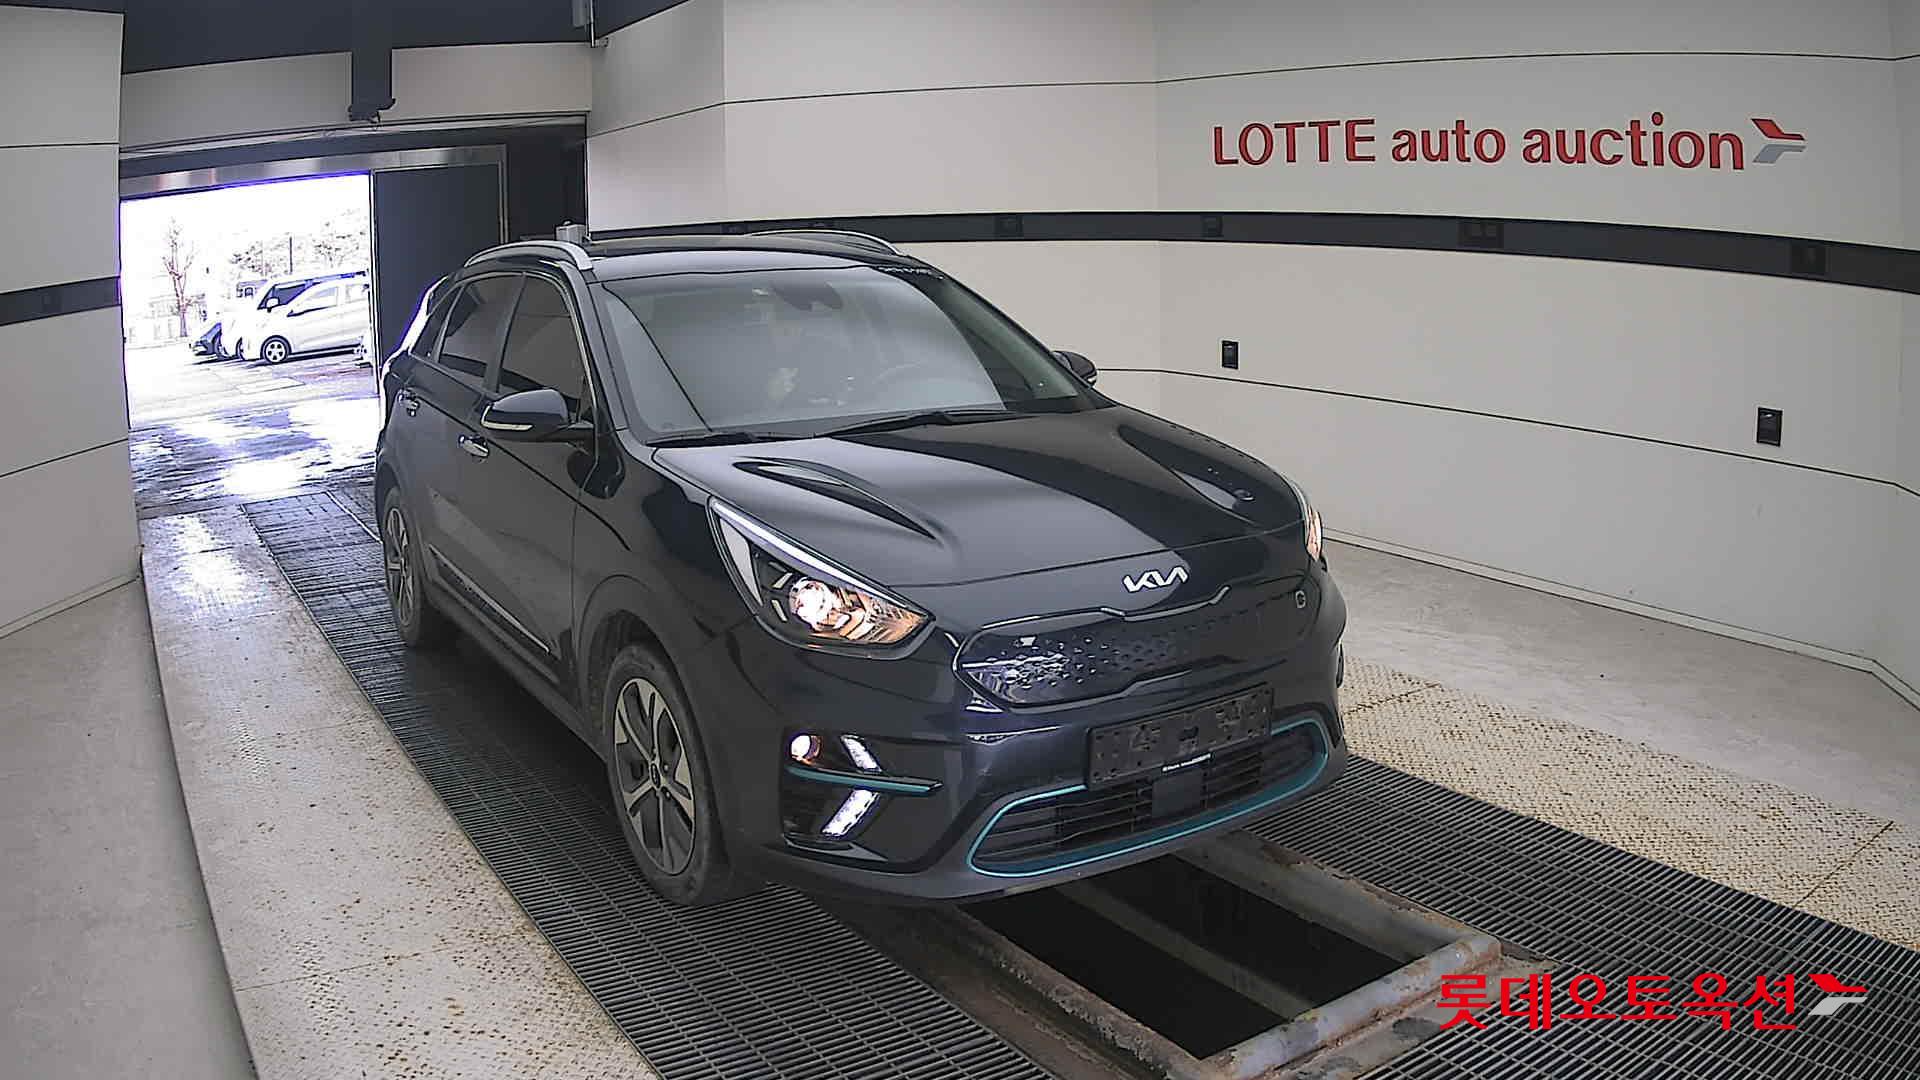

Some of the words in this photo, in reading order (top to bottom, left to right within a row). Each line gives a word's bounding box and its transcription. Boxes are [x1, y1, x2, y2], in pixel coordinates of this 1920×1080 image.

[1212, 117, 1377, 165] LOTTE
[1391, 119, 1507, 165] auto
[1520, 111, 1745, 171] auction
[1122, 566, 1189, 593] KIA
